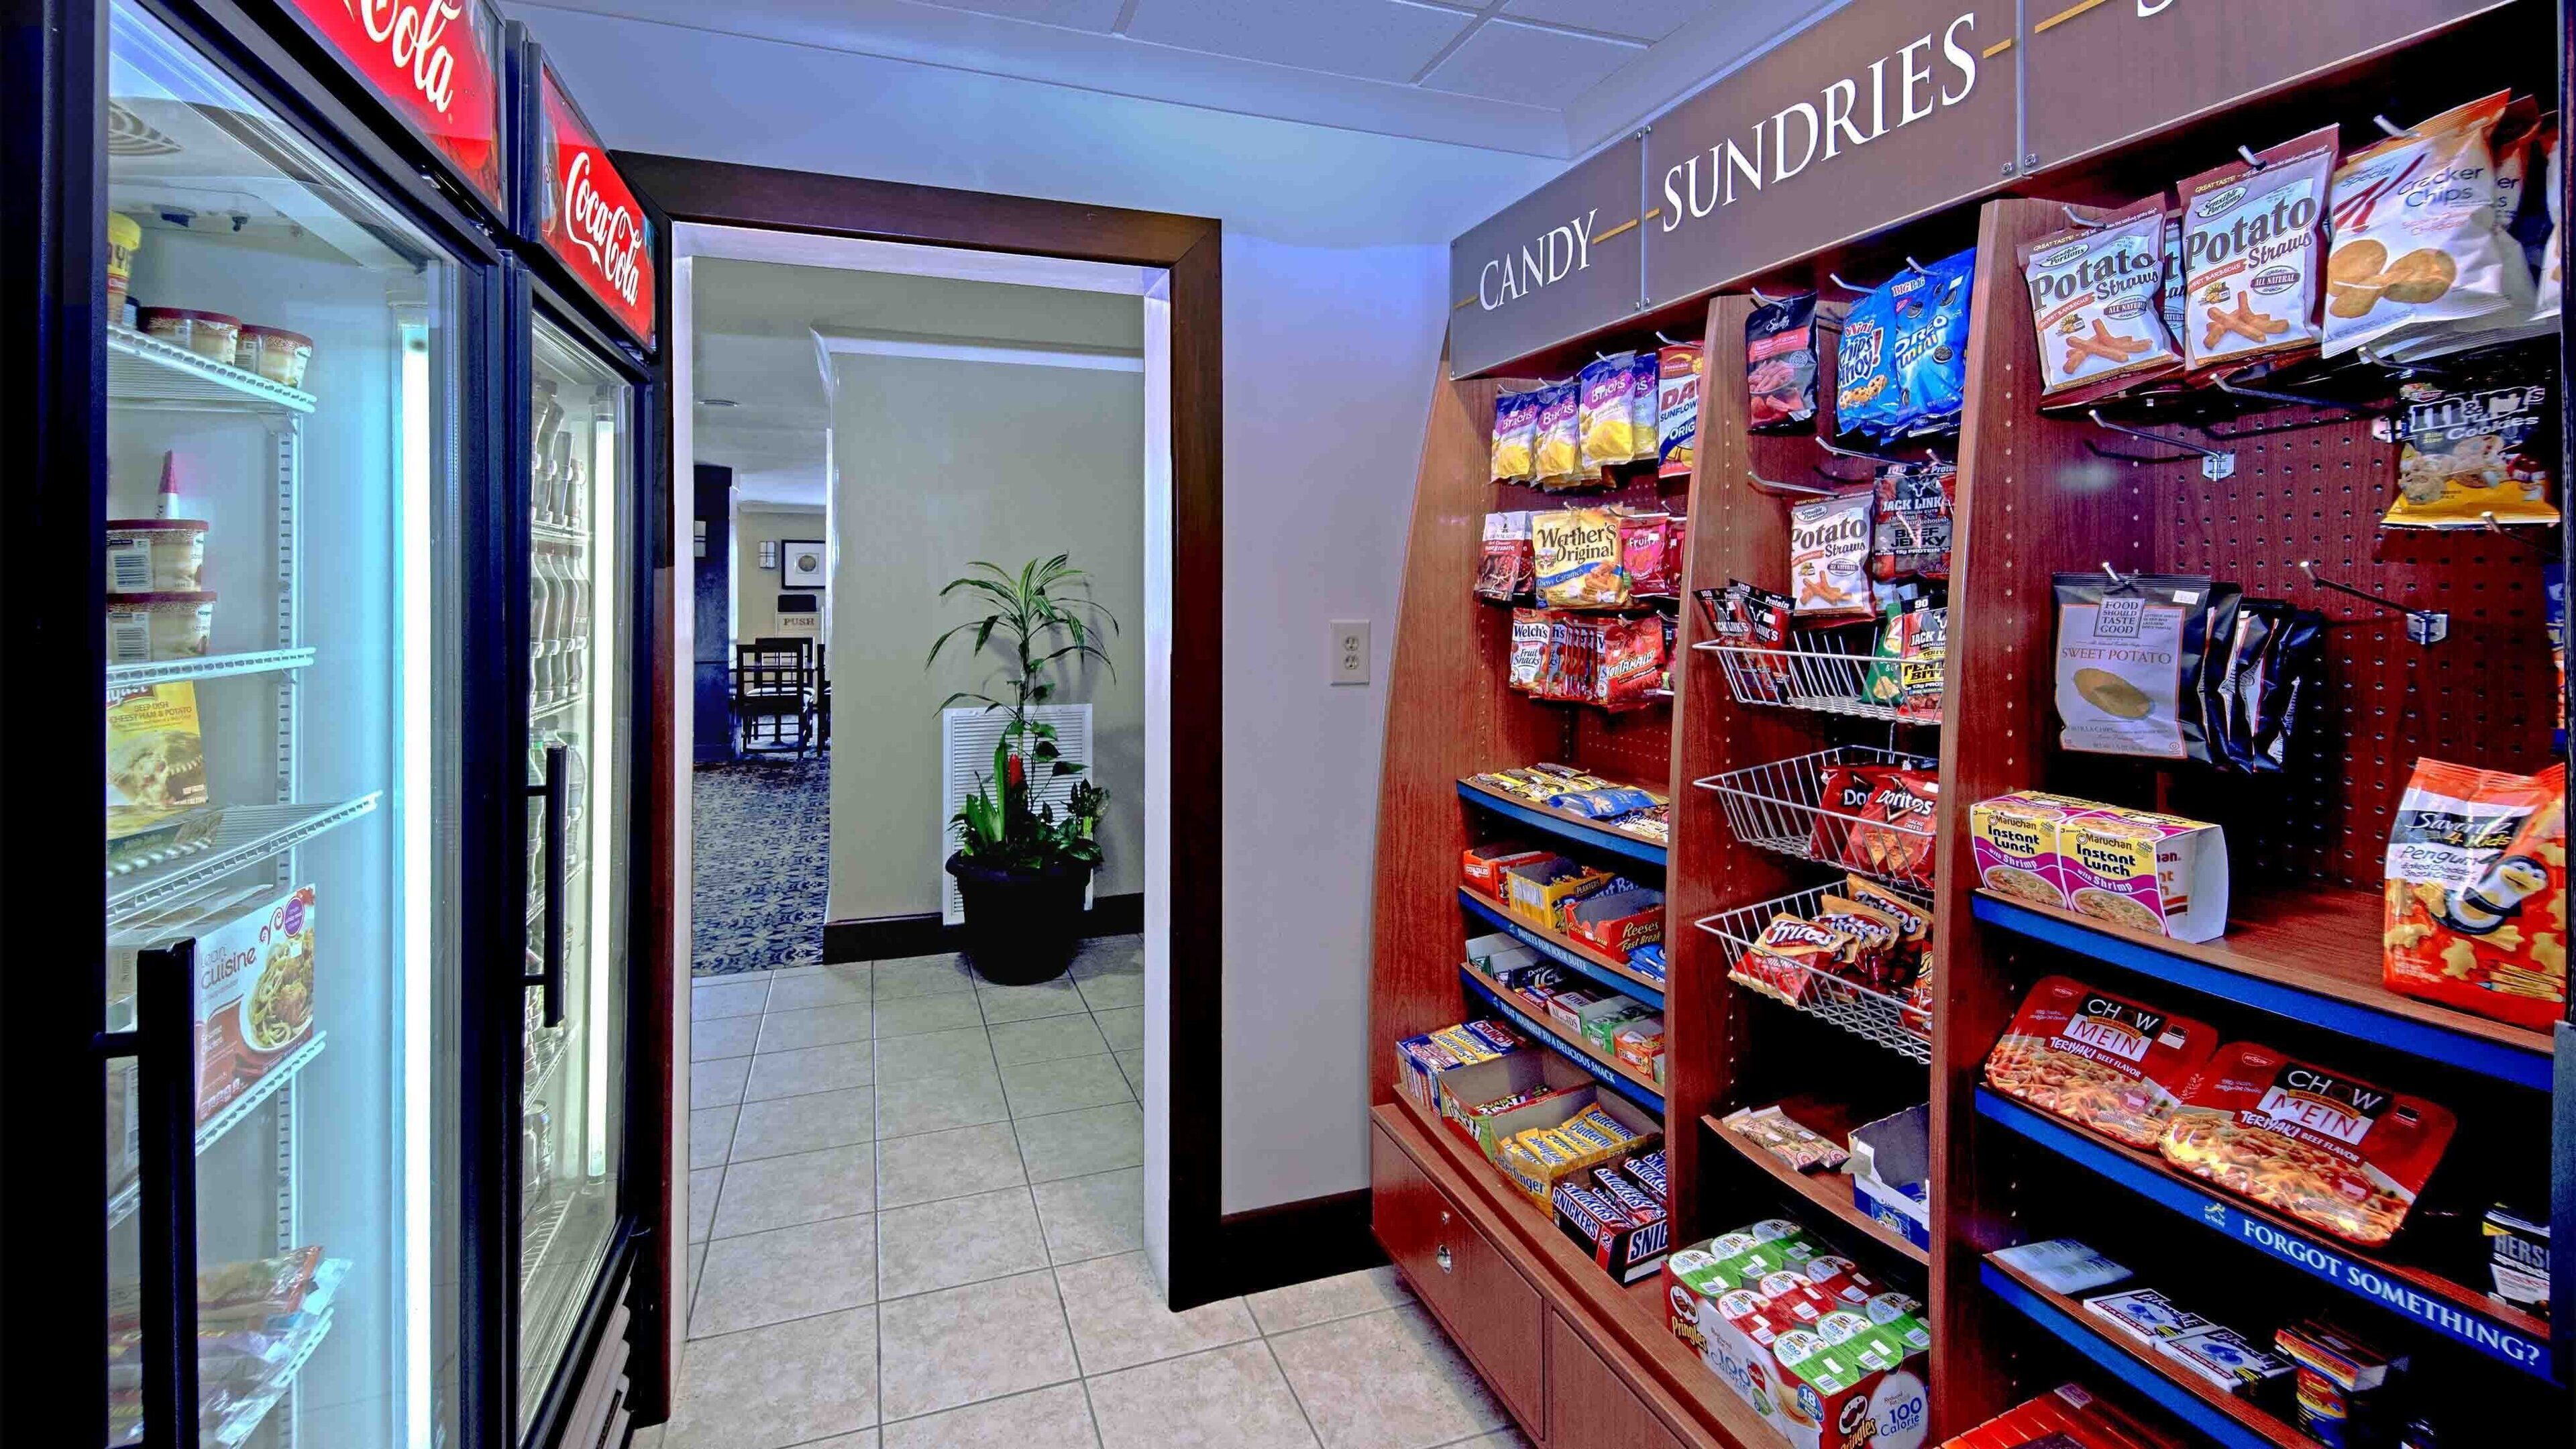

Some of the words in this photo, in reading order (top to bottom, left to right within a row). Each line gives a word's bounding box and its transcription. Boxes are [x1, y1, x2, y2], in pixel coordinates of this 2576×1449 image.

[1662, 12, 1977, 233] SUNDRIES
[565, 152, 643, 307] Coca-Cola
[2186, 197, 2316, 272] Potato
[1479, 209, 1598, 311] CANDY
[2248, 232, 2313, 269] Straws
[1892, 282, 1911, 296] BIG
[1911, 277, 1925, 290] BAG
[2029, 249, 2160, 312] Potato
[2095, 270, 2158, 301] Straws
[2267, 274, 2295, 284] NATURAL
[1894, 315, 1948, 358] OREO
[1882, 499, 1913, 512] JACK
[1537, 522, 1617, 548] Werther's
[1890, 535, 1947, 547] JEKY
[1556, 539, 1614, 564] Original
[1825, 541, 1866, 557] Straws
[1764, 595, 1790, 609] Protein
[1915, 598, 1929, 609] 90
[2104, 601, 2139, 610] FOOD
[783, 617, 815, 627] PUSH
[2100, 625, 2133, 635] GOOD
[2102, 616, 2136, 625] TASTE
[1513, 625, 1548, 639] Welch's
[1911, 631, 1935, 647] JACK
[1513, 655, 1542, 665] Snacks
[1520, 649, 1538, 659] Fruit
[2062, 648, 2104, 660] SWEET
[2108, 649, 2171, 665] POTATO
[1875, 789, 1935, 815] Doritos
[1995, 814, 2037, 831] Maruchan
[1988, 824, 2040, 845] Instant
[2085, 833, 2133, 851] Maruchan
[1994, 838, 2035, 855] Lunch
[2076, 842, 2136, 867] Instant
[1988, 848, 2002, 859] with
[2002, 853, 2038, 871] Shrimp
[2083, 857, 2131, 877] Lunch
[1576, 878, 1601, 895] PLANTERS
[2093, 875, 2134, 893] Shrimp
[1517, 928, 1539, 946] SWEETS
[2087, 998, 2159, 1031] CHOW
[2074, 1020, 2144, 1056] MEIN
[1542, 1030, 1552, 1043] TO
[1550, 1036, 1557, 1047] A
[1556, 1039, 1591, 1068] DELICIOUS
[1591, 1061, 1616, 1085] SNACK
[2050, 1036, 2097, 1059] TERIYAKI
[2096, 1053, 2114, 1065] BEEF
[2113, 1060, 2141, 1077] FLAVOR
[2287, 1070, 2383, 1110] CHOW
[2269, 1093, 2359, 1137] MEIN
[2241, 1110, 2302, 1138] TERIYAKI
[2301, 1132, 2324, 1148] BEEF
[2323, 1141, 2361, 1163] FLAVOR
[1553, 1189, 1599, 1240] SNICKERS
[1602, 1231, 1612, 1244] 2
[2243, 1219, 2345, 1278] FORGOT
[2347, 1265, 2541, 1366] SOMETHING?
[2096, 1301, 2154, 1336] STANDARD
[1671, 1316, 1709, 1354] Pringles
[2169, 1340, 2233, 1380] STANDARD
[1802, 1387, 1817, 1407] 18
[1889, 1397, 1923, 1424] 100
[1880, 1414, 1920, 1436] Calorie
